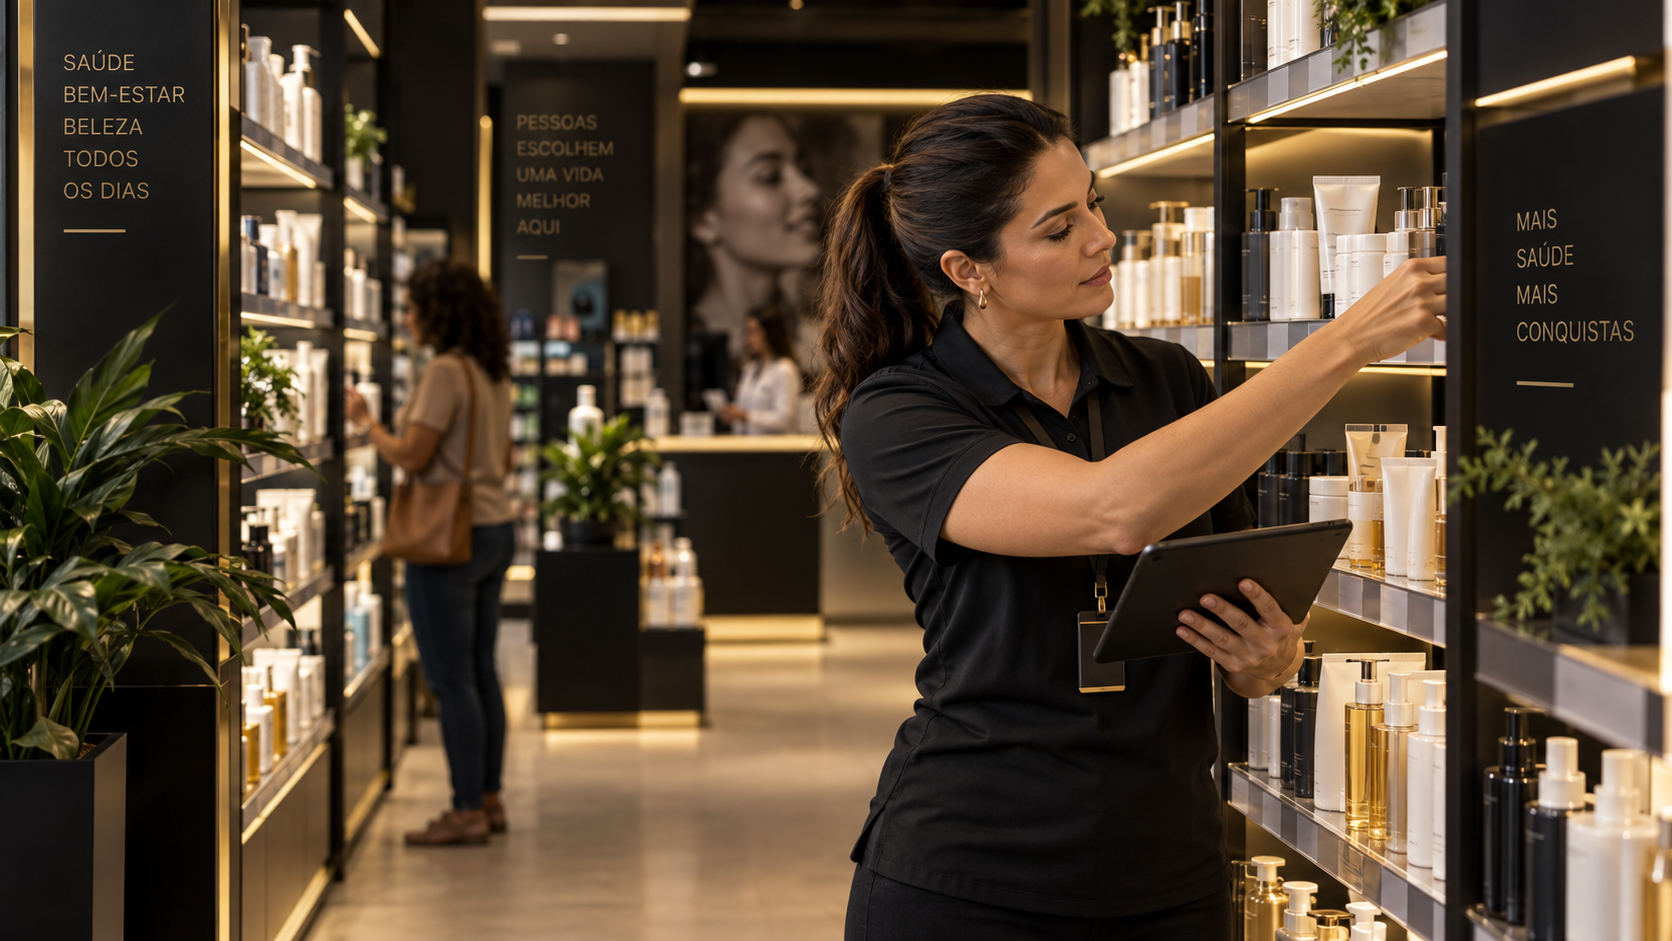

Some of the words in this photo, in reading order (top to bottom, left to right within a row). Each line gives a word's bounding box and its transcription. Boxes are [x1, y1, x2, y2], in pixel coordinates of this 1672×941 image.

[63, 49, 135, 71] SAÚDE
[63, 86, 185, 103] BEM-ESTAR
[63, 118, 143, 135] BELEZA
[516, 114, 597, 131] PESSOAS
[516, 140, 614, 157] ESCOLHEM
[63, 150, 139, 167] TODOS
[516, 167, 557, 183] UMA
[562, 167, 604, 183] VIDA
[63, 182, 93, 199] OS
[101, 182, 150, 199] DIAS
[516, 193, 591, 209] MELHOR
[516, 219, 560, 236] AQUI
[1516, 208, 1558, 231] MAIS
[1516, 241, 1574, 268] SAÚDE
[1516, 283, 1558, 305] MAIS
[1516, 319, 1635, 344] CONQUISTAS
